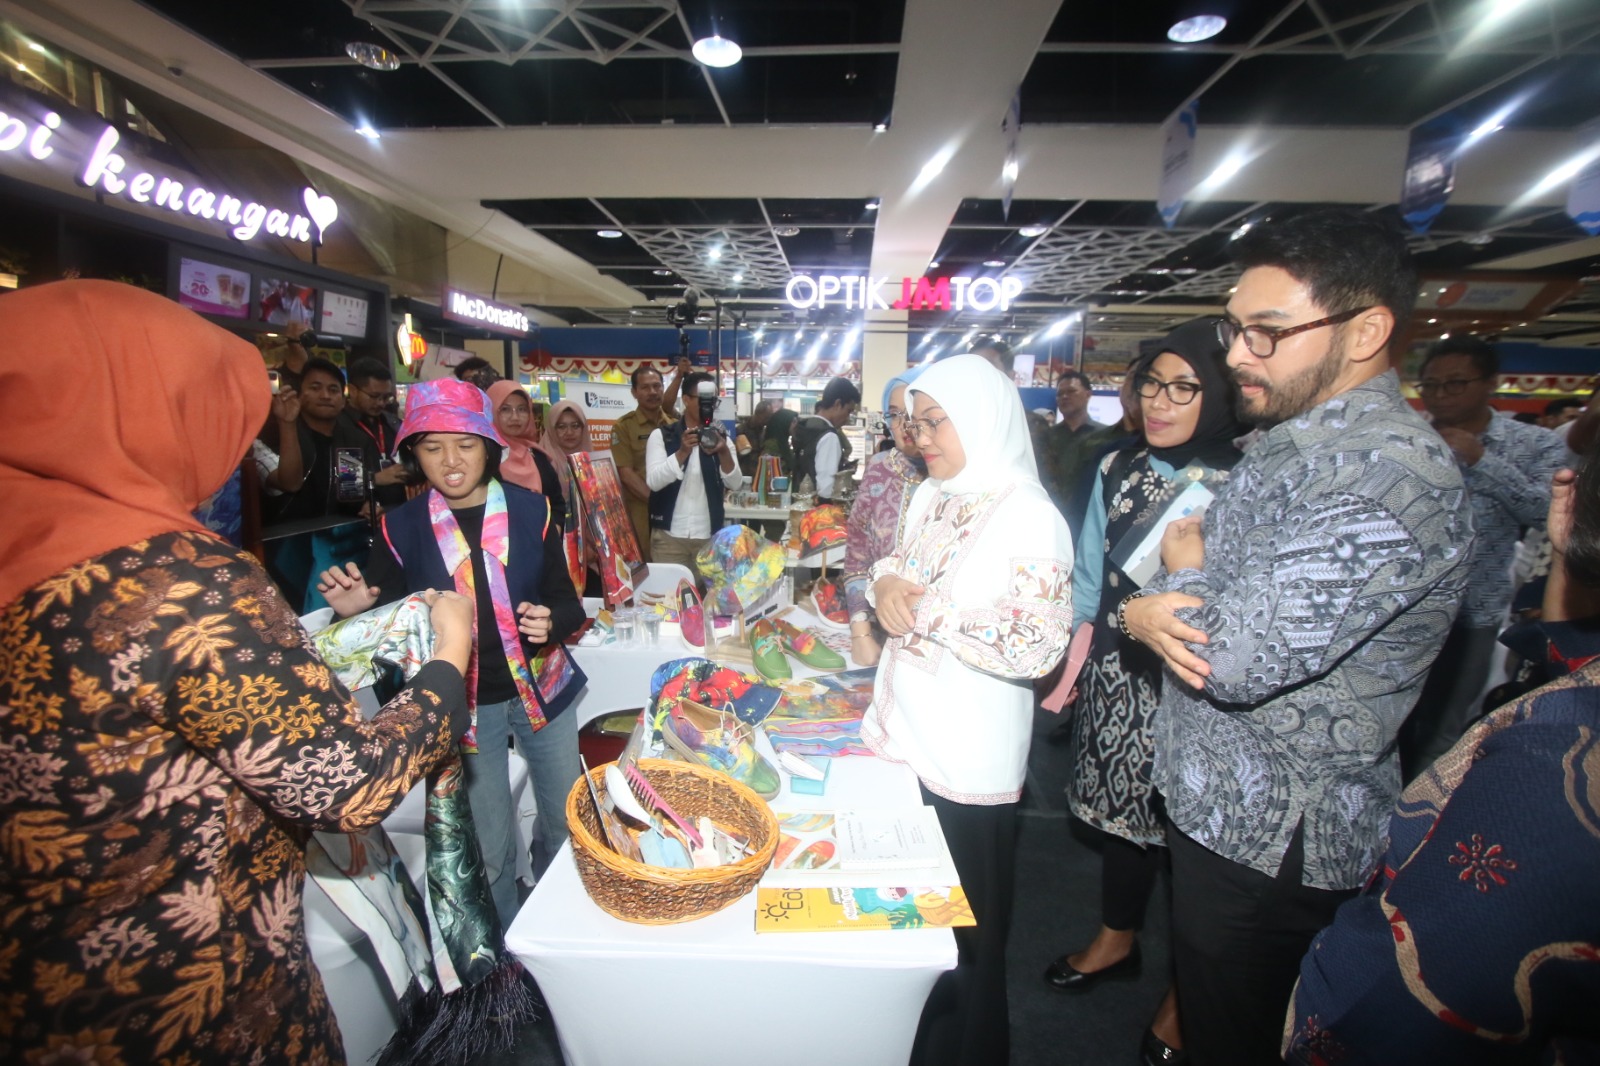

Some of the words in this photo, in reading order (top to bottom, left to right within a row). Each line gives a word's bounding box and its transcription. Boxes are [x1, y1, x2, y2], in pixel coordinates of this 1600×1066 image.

[83, 126, 310, 241] kenangan
[785, 275, 890, 310] OPTIK
[453, 293, 529, 332] McDonald's
